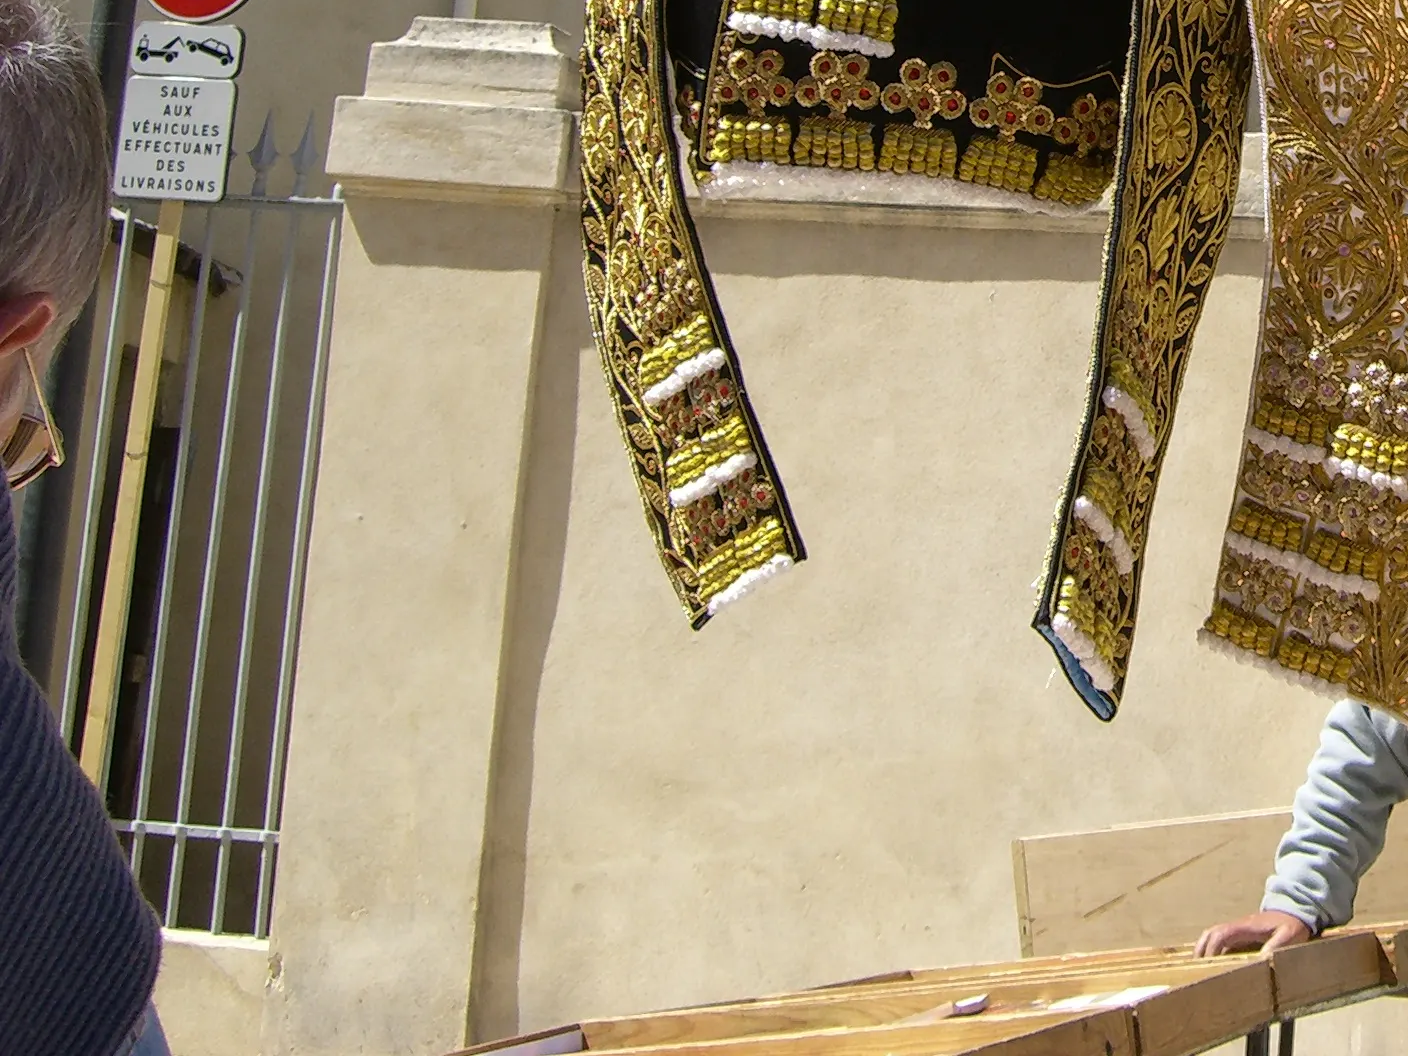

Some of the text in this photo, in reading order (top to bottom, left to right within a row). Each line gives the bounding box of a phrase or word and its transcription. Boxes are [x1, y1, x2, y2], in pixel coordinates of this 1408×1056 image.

[160, 86, 200, 99] SAUF
[163, 104, 192, 117] AUX
[132, 119, 220, 137] VÉHICULES
[124, 139, 222, 156] EFFECTUANT
[156, 159, 185, 173] DES
[121, 176, 215, 193] LIVRAISONS
